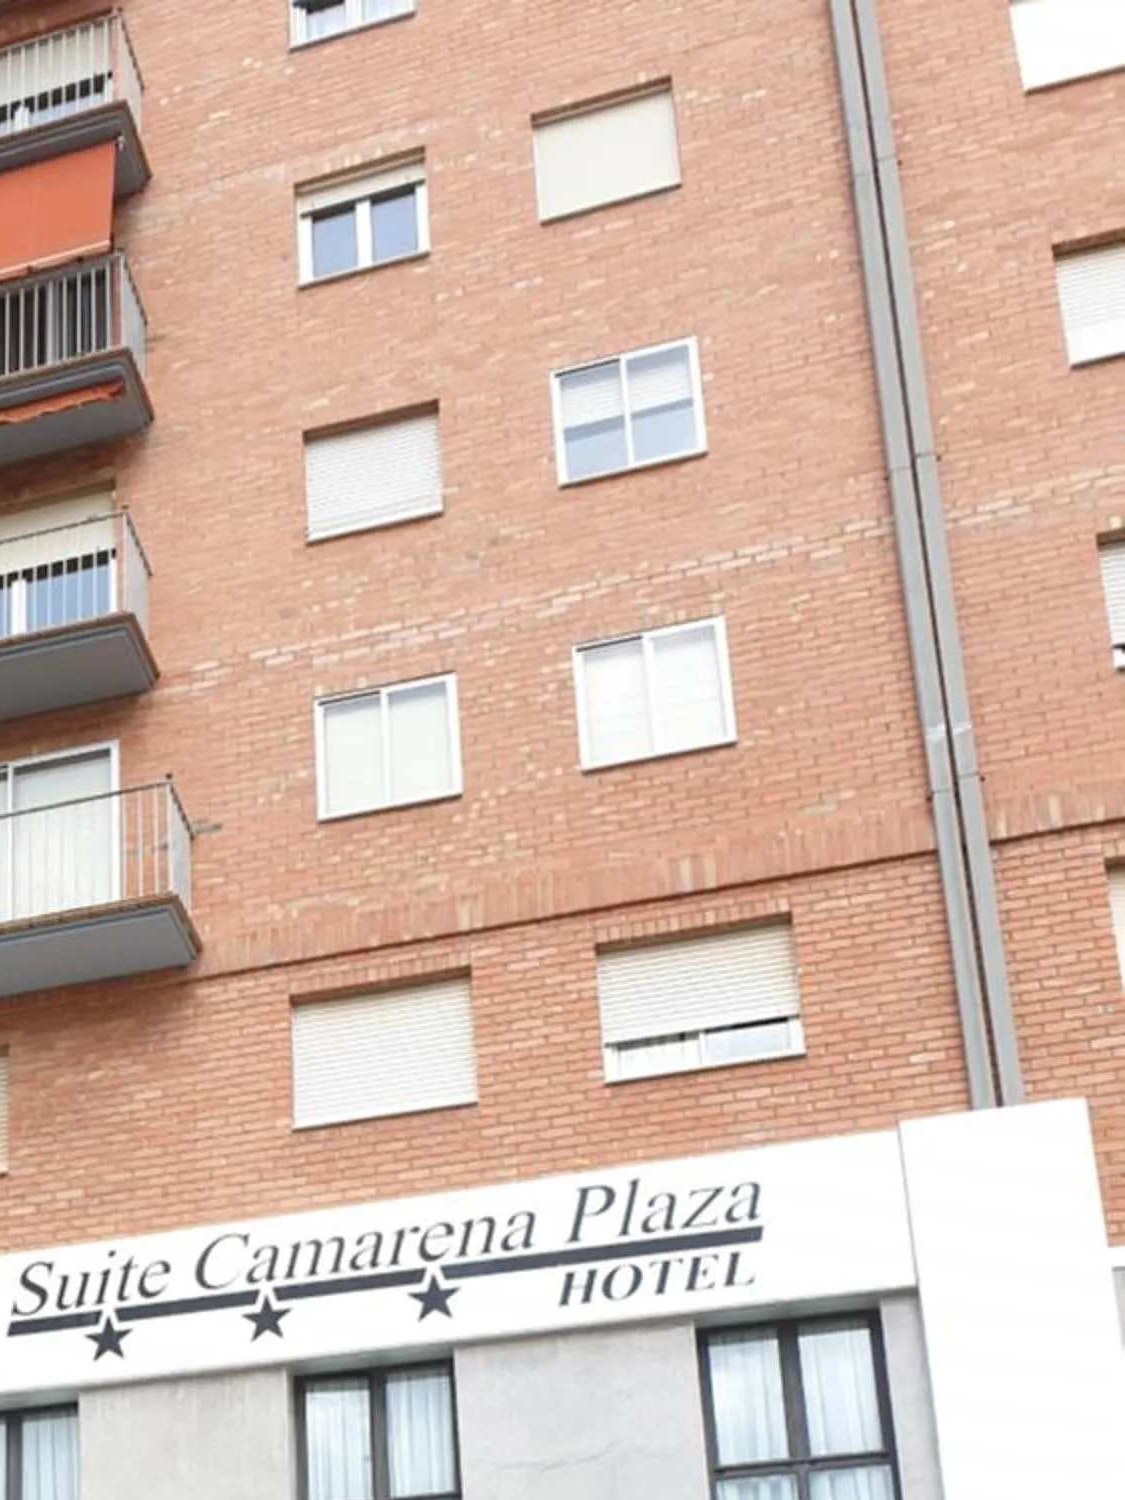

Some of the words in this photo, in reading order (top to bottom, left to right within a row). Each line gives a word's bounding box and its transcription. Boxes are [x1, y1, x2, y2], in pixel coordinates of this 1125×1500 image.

[10, 1249, 172, 1317] Suite
[194, 1210, 538, 1291] Camarena
[565, 1178, 762, 1244] Plaza
[558, 1251, 756, 1307] HOTEL
